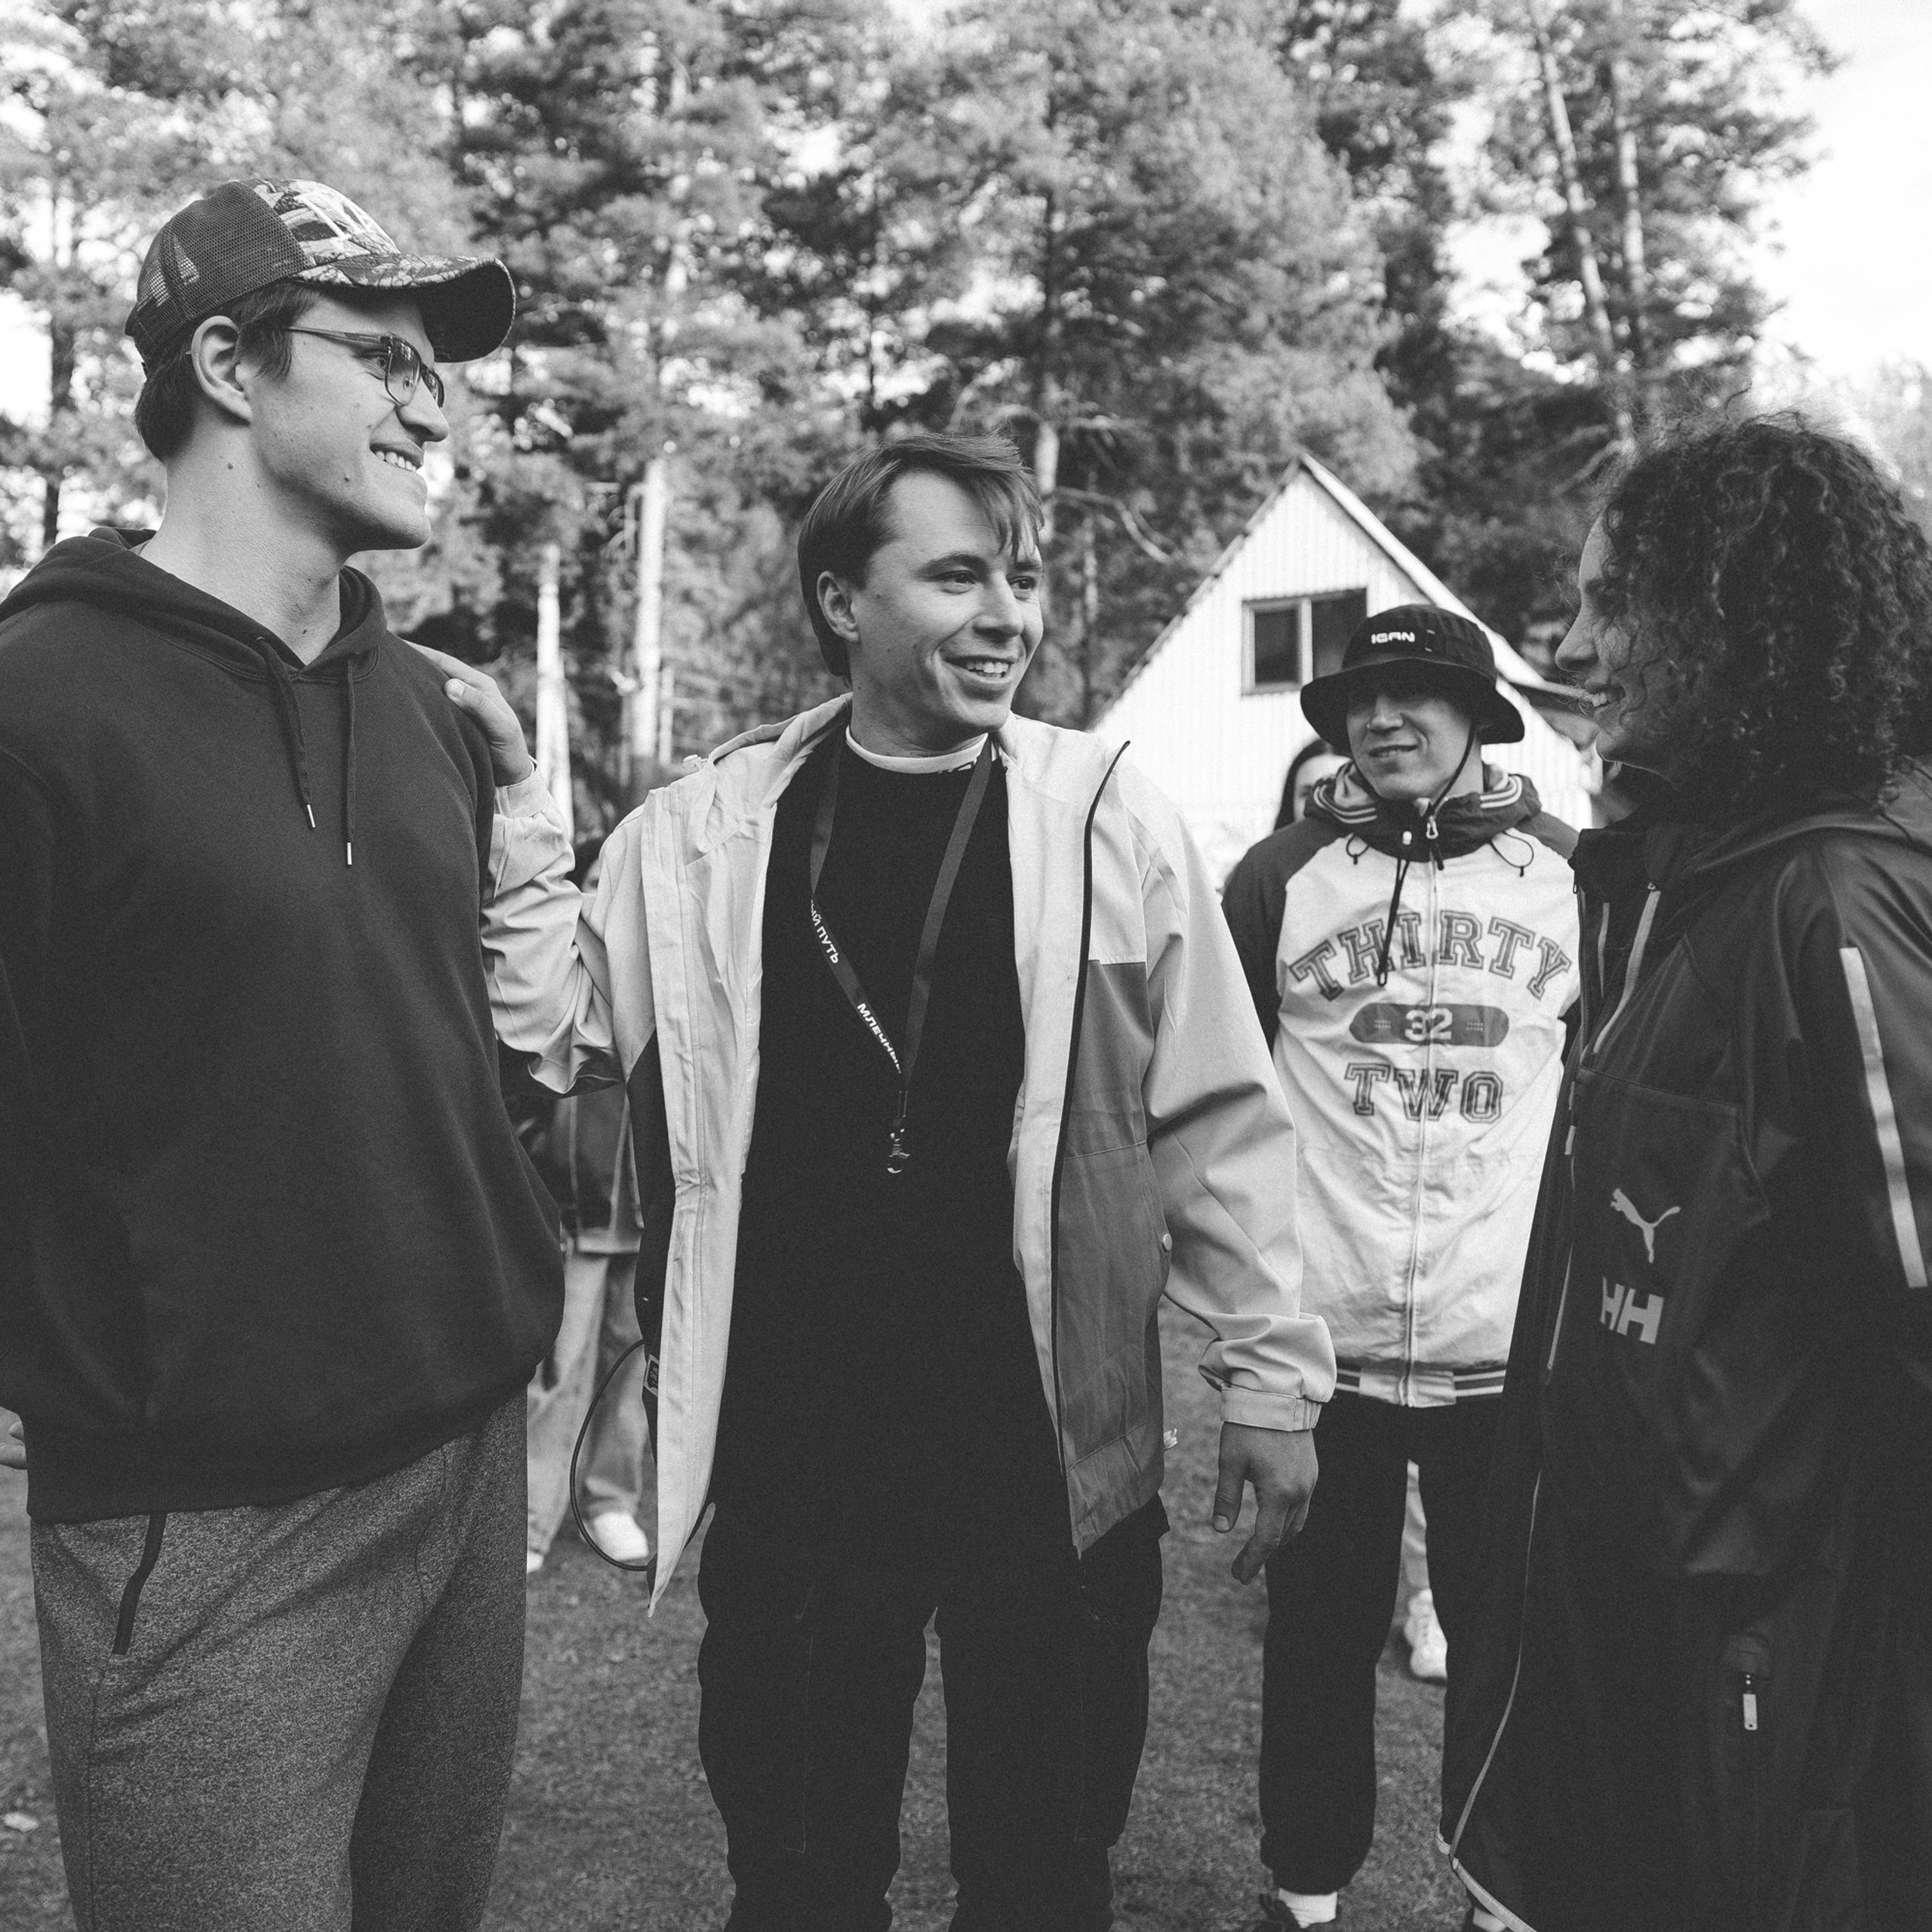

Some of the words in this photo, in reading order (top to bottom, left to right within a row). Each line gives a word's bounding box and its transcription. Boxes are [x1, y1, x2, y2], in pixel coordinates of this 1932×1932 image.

[817, 926, 838, 964] ПУТЬ
[1289, 910, 1572, 1001] THIRTY
[1404, 1008, 1454, 1041] 32
[1344, 1063, 1504, 1124] TWO
[1601, 1276, 1664, 1344] HH
